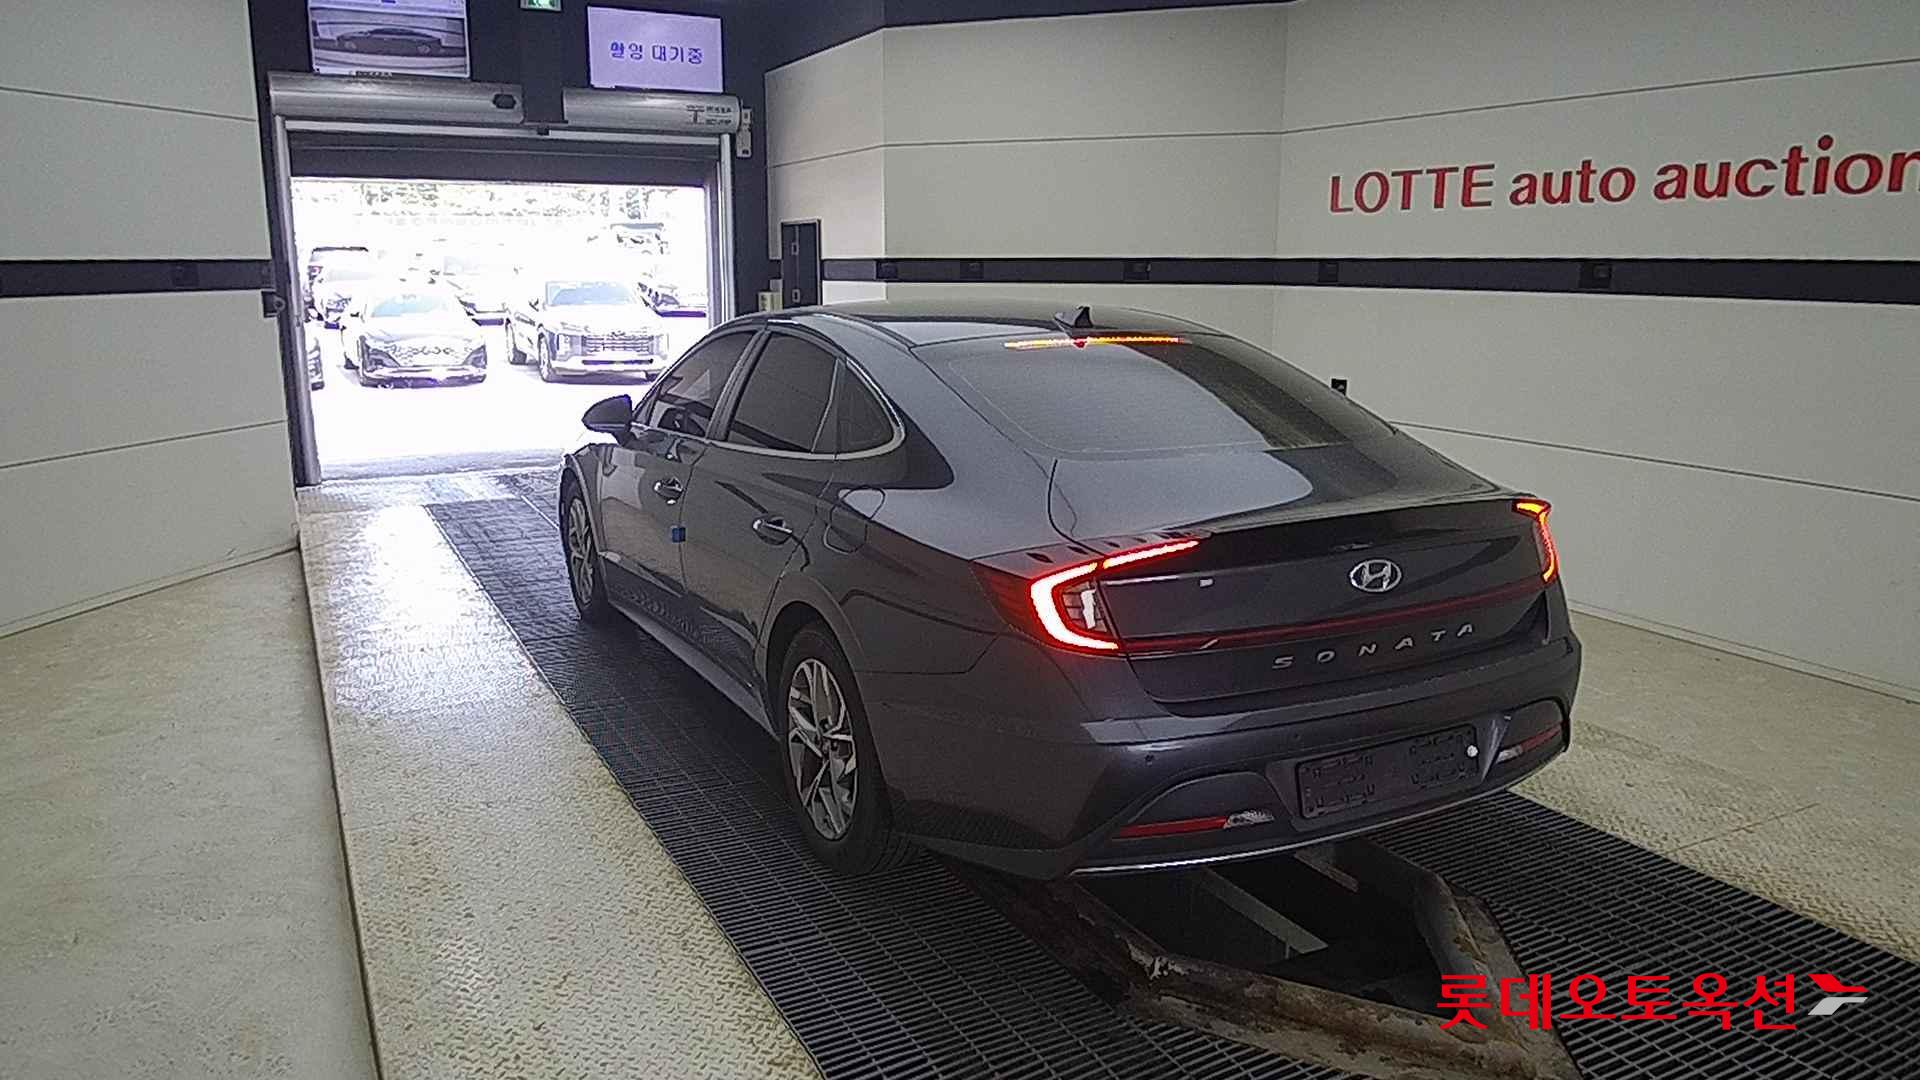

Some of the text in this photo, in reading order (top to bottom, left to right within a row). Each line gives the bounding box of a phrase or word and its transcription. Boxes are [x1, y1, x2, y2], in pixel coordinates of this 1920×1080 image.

[651, 44, 702, 65] 대기중
[1330, 163, 1496, 214] LOTTE
[1509, 159, 1636, 206] auto
[1271, 623, 1474, 670] SONATA
